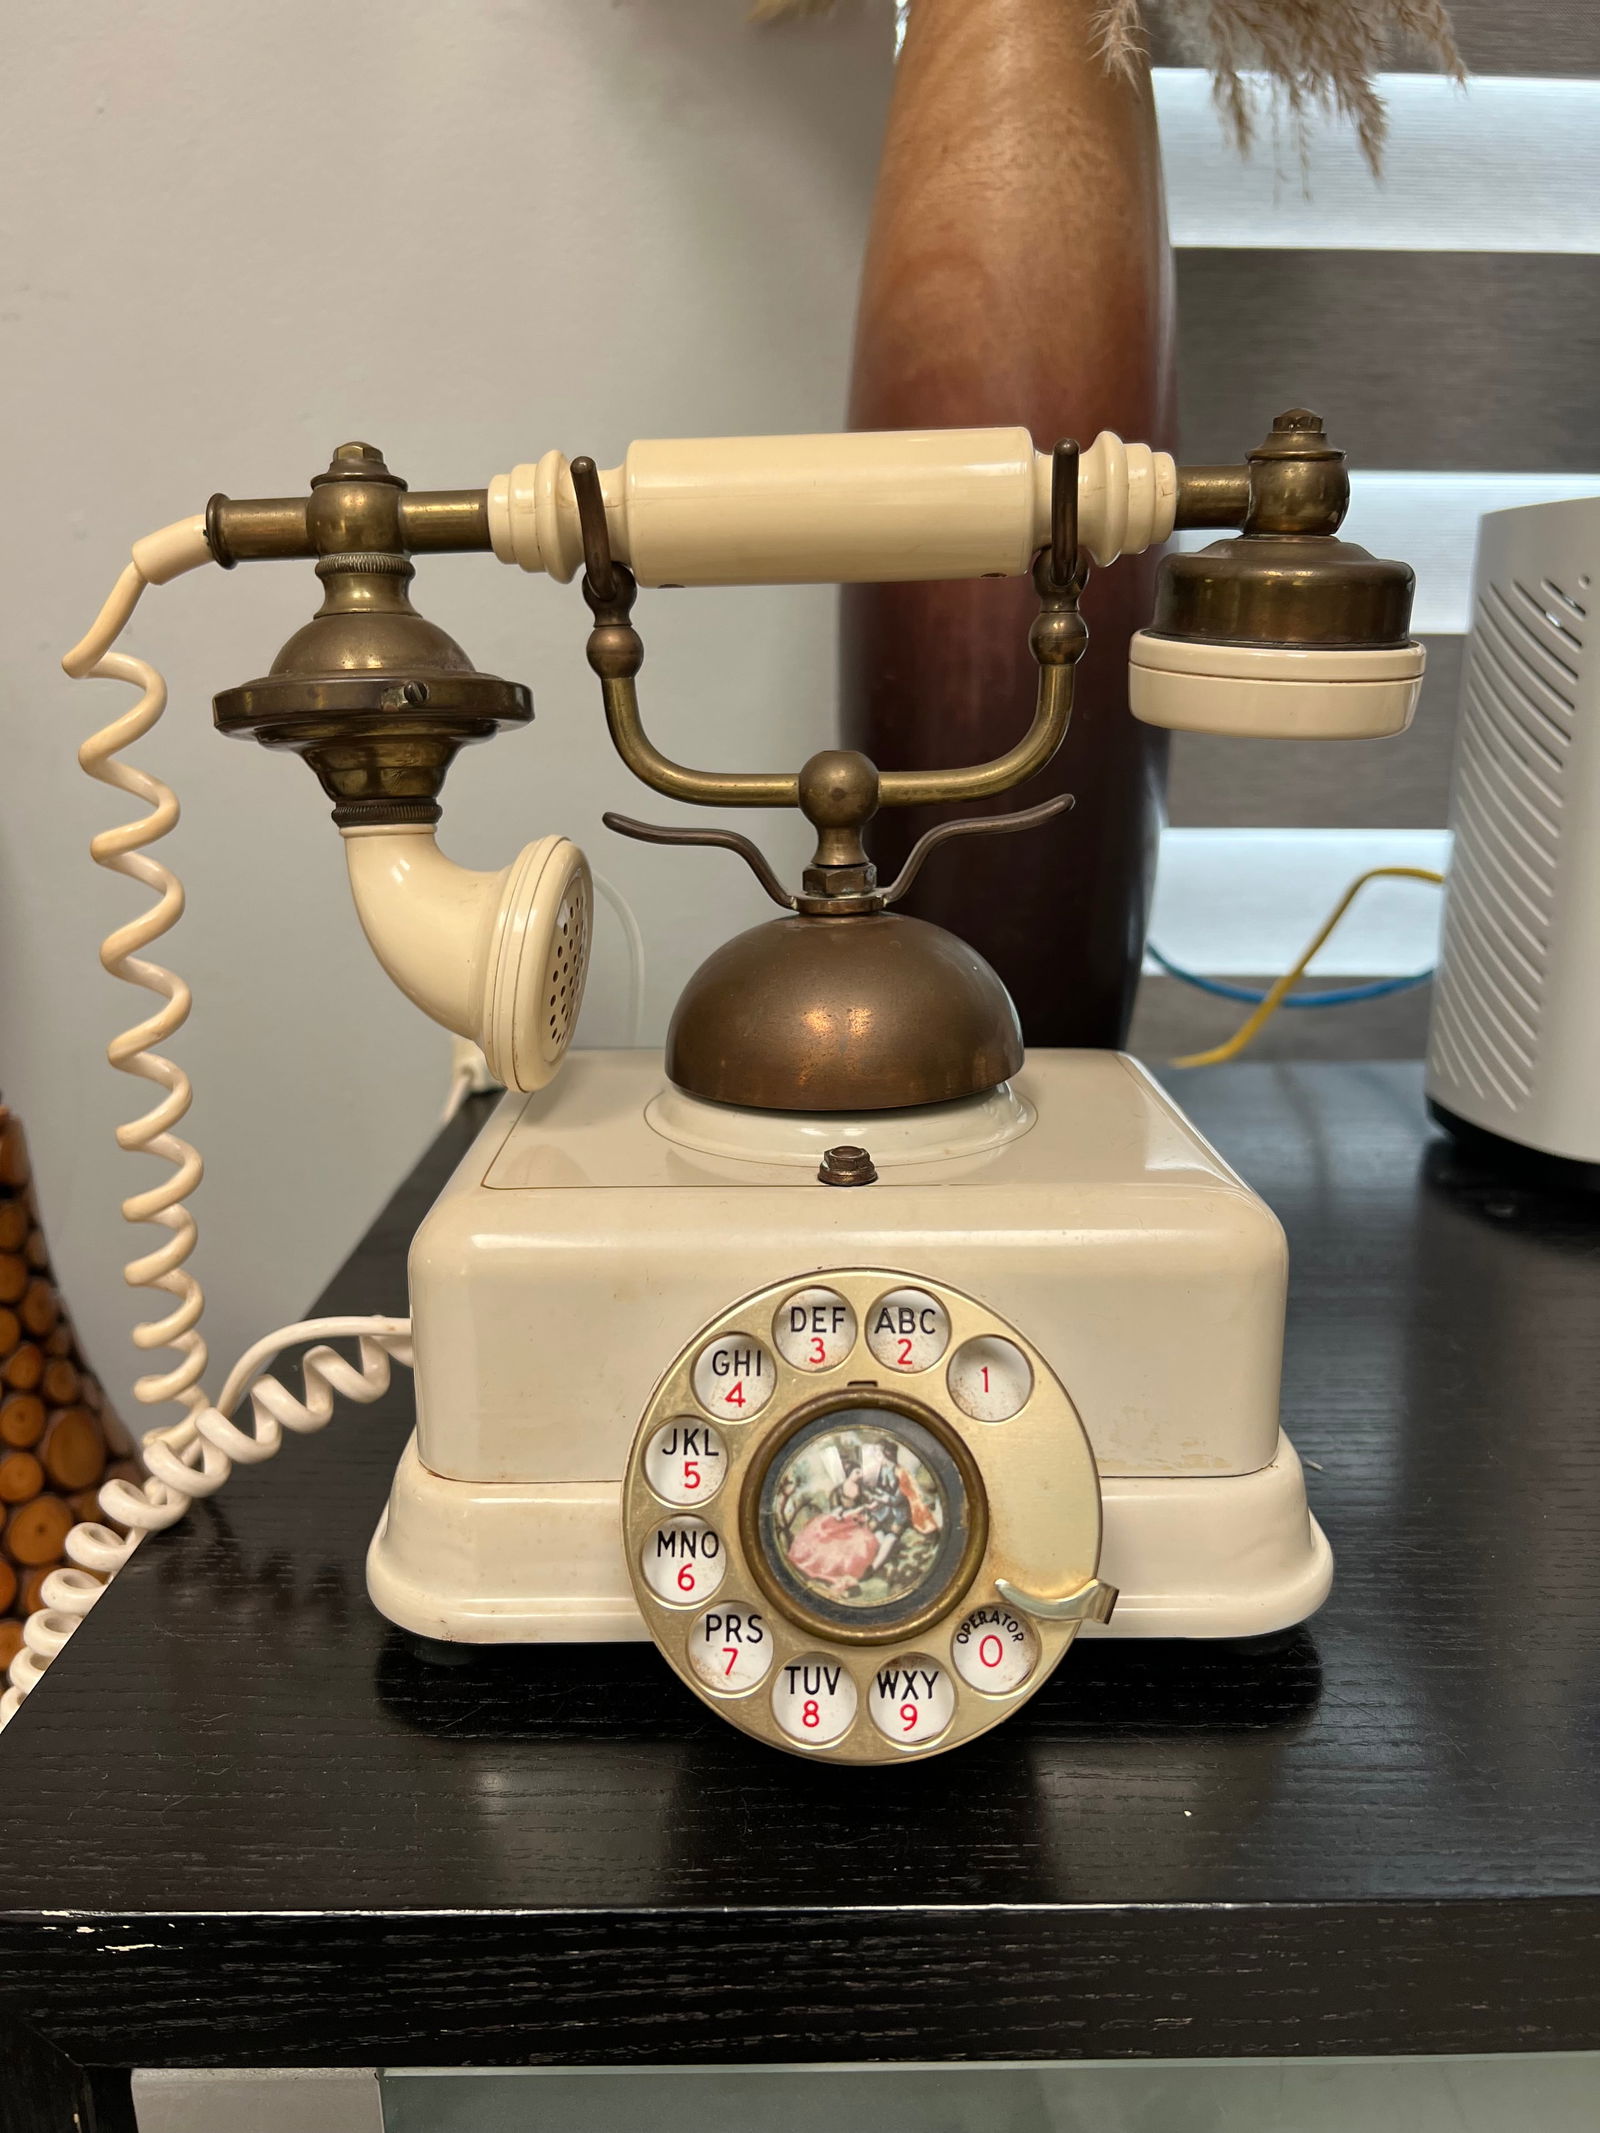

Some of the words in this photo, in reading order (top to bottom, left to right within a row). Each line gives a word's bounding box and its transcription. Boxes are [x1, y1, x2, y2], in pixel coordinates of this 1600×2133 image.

[790, 1306, 846, 1332] DEF
[875, 1306, 936, 1334] ABC
[712, 1350, 762, 1377] GHI
[808, 1337, 827, 1365] 3
[897, 1338, 913, 1366] 2
[980, 1366, 990, 1393] 1
[724, 1381, 747, 1409] 4
[662, 1428, 719, 1456] JKL
[683, 1461, 702, 1490] 5
[657, 1530, 719, 1557] MNO
[676, 1562, 696, 1592] 6
[705, 1613, 763, 1642] PRS
[956, 1610, 1024, 1644] OPERATOR
[721, 1647, 739, 1676] 7
[784, 1666, 841, 1695] TUV
[877, 1670, 940, 1699] WXY
[801, 1699, 821, 1729] 8
[899, 1703, 919, 1732] 9
